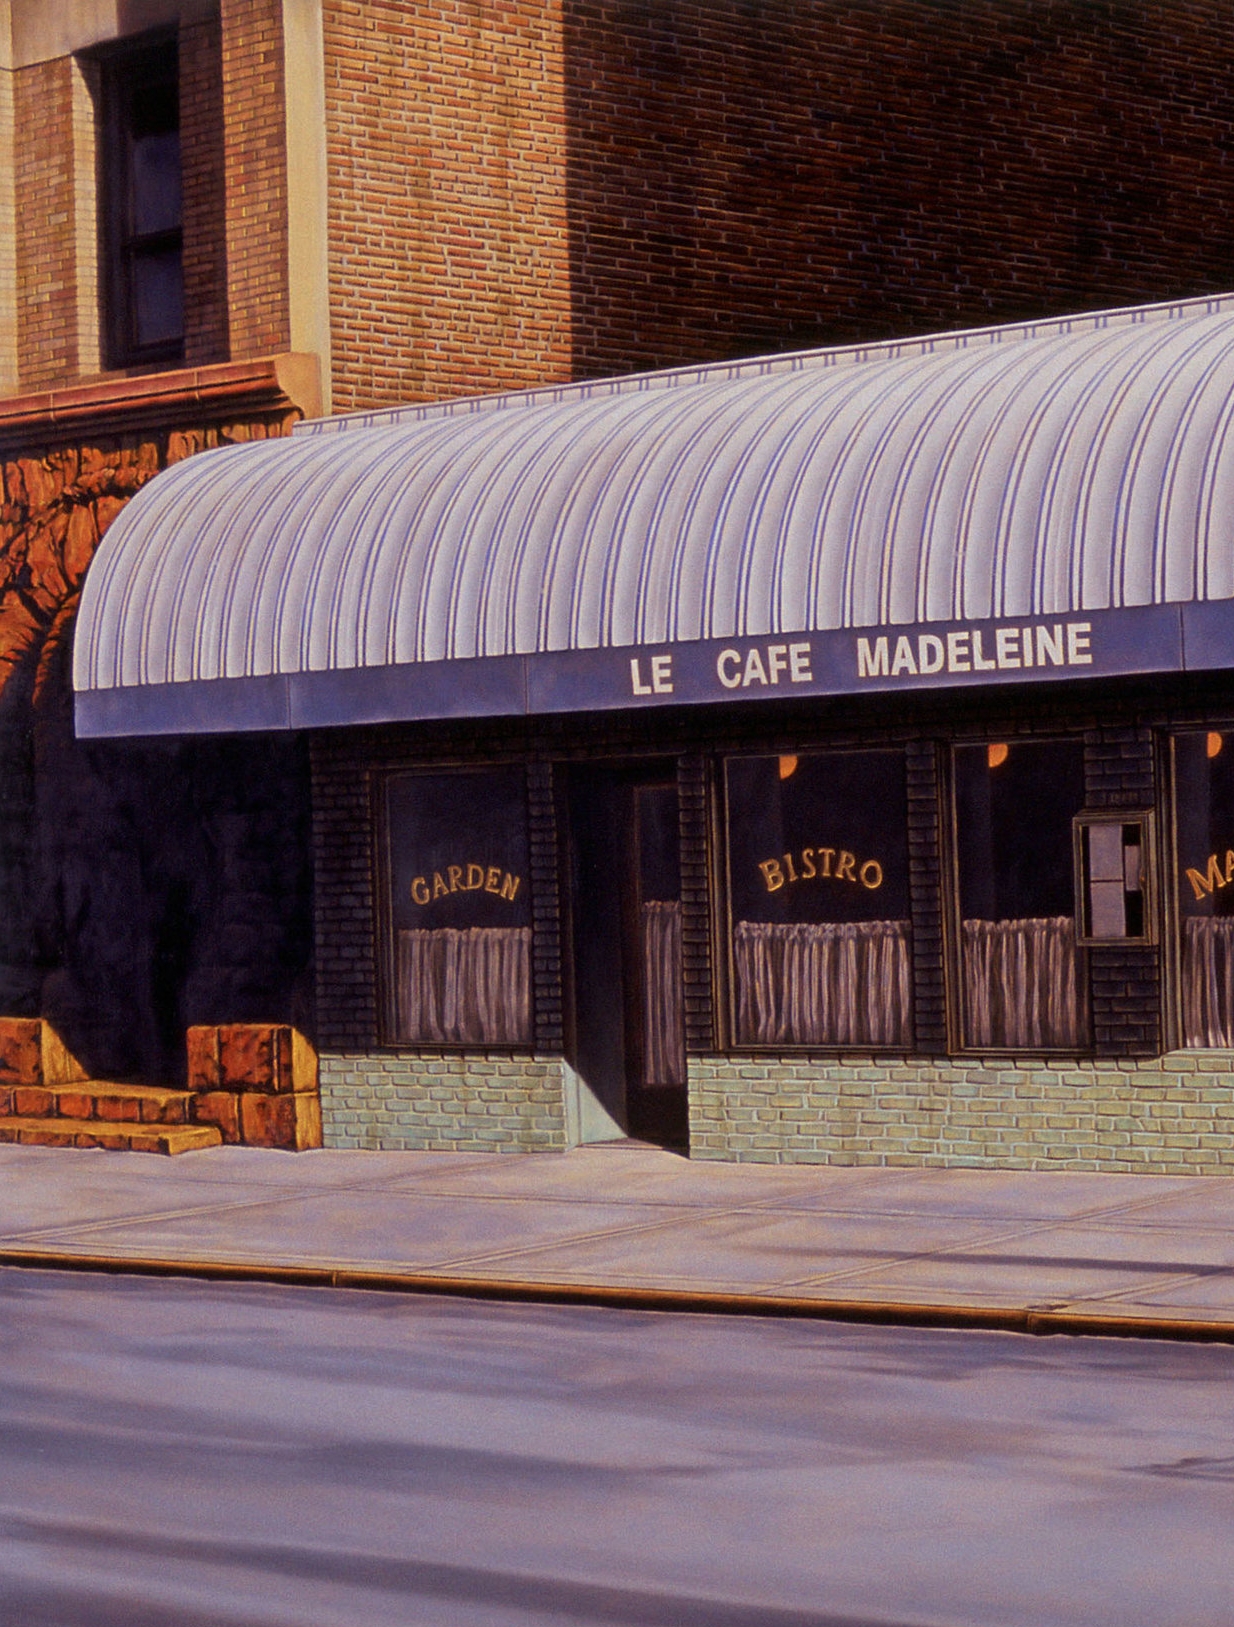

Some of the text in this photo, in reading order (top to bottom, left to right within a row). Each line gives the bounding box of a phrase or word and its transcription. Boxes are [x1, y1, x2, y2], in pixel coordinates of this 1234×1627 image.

[630, 623, 1093, 696] LE CAFE MADELEINE
[410, 863, 521, 905] GARDEN
[758, 847, 884, 892] BISTRO
